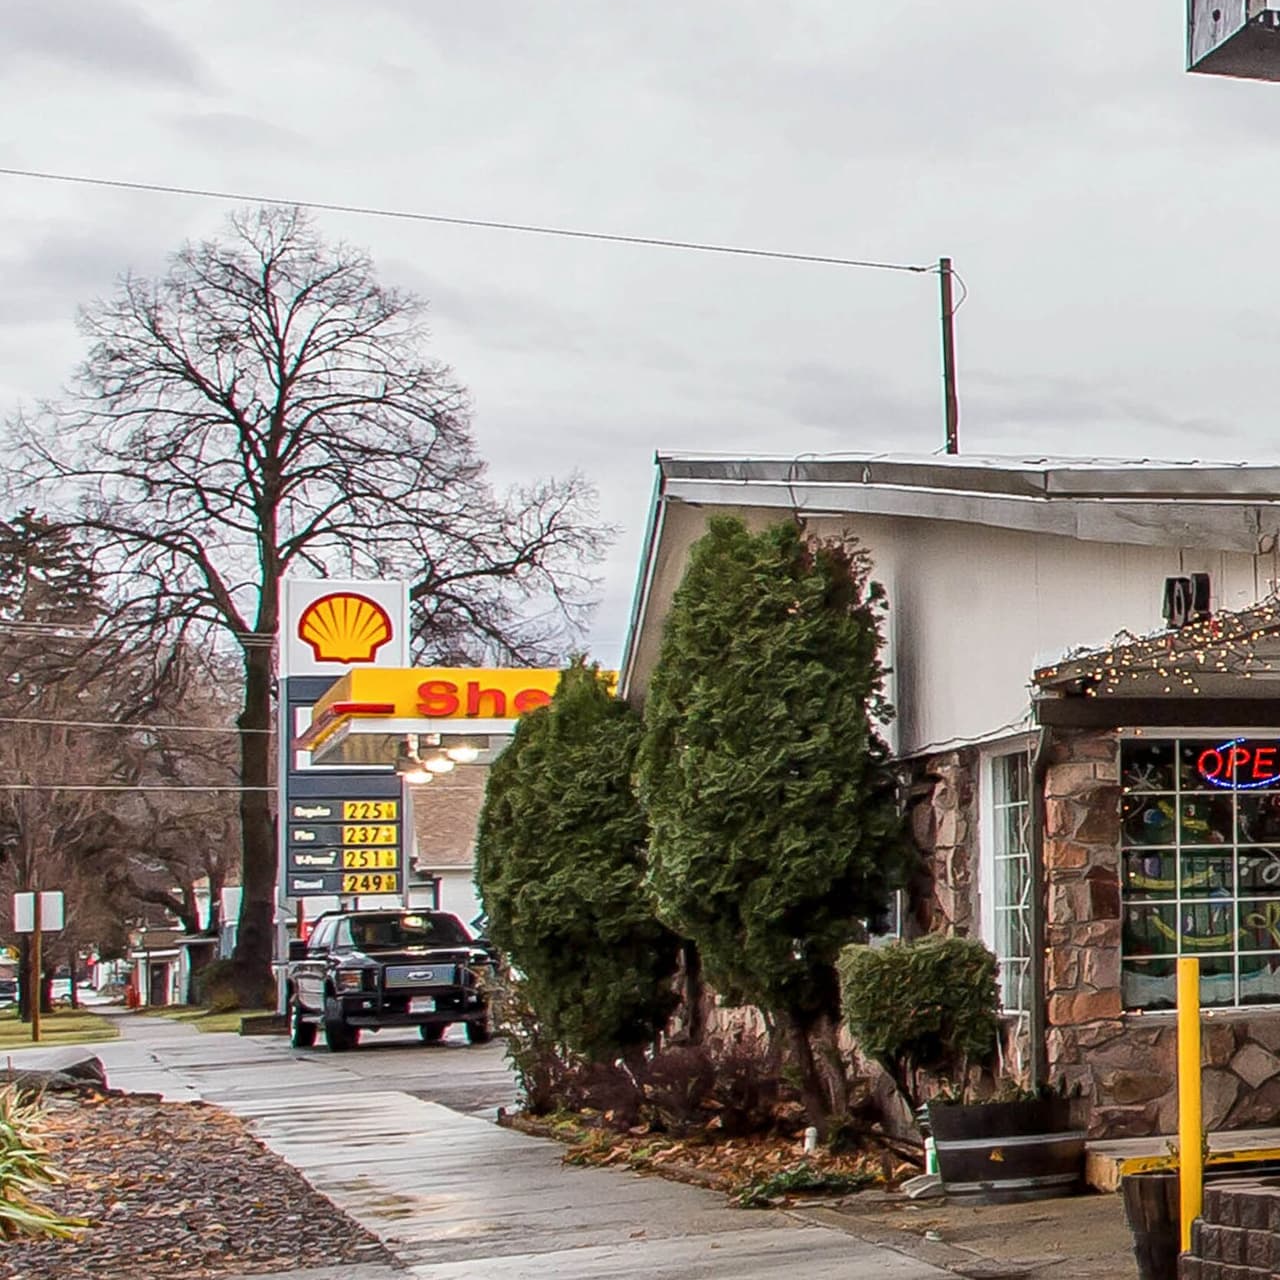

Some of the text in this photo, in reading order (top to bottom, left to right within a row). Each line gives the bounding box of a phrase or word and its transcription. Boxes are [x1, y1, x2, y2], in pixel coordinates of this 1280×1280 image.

[416, 680, 553, 717] She
[348, 803, 382, 819] 225
[346, 827, 380, 843] 237
[346, 851, 379, 867] 251
[348, 875, 382, 892] 249
